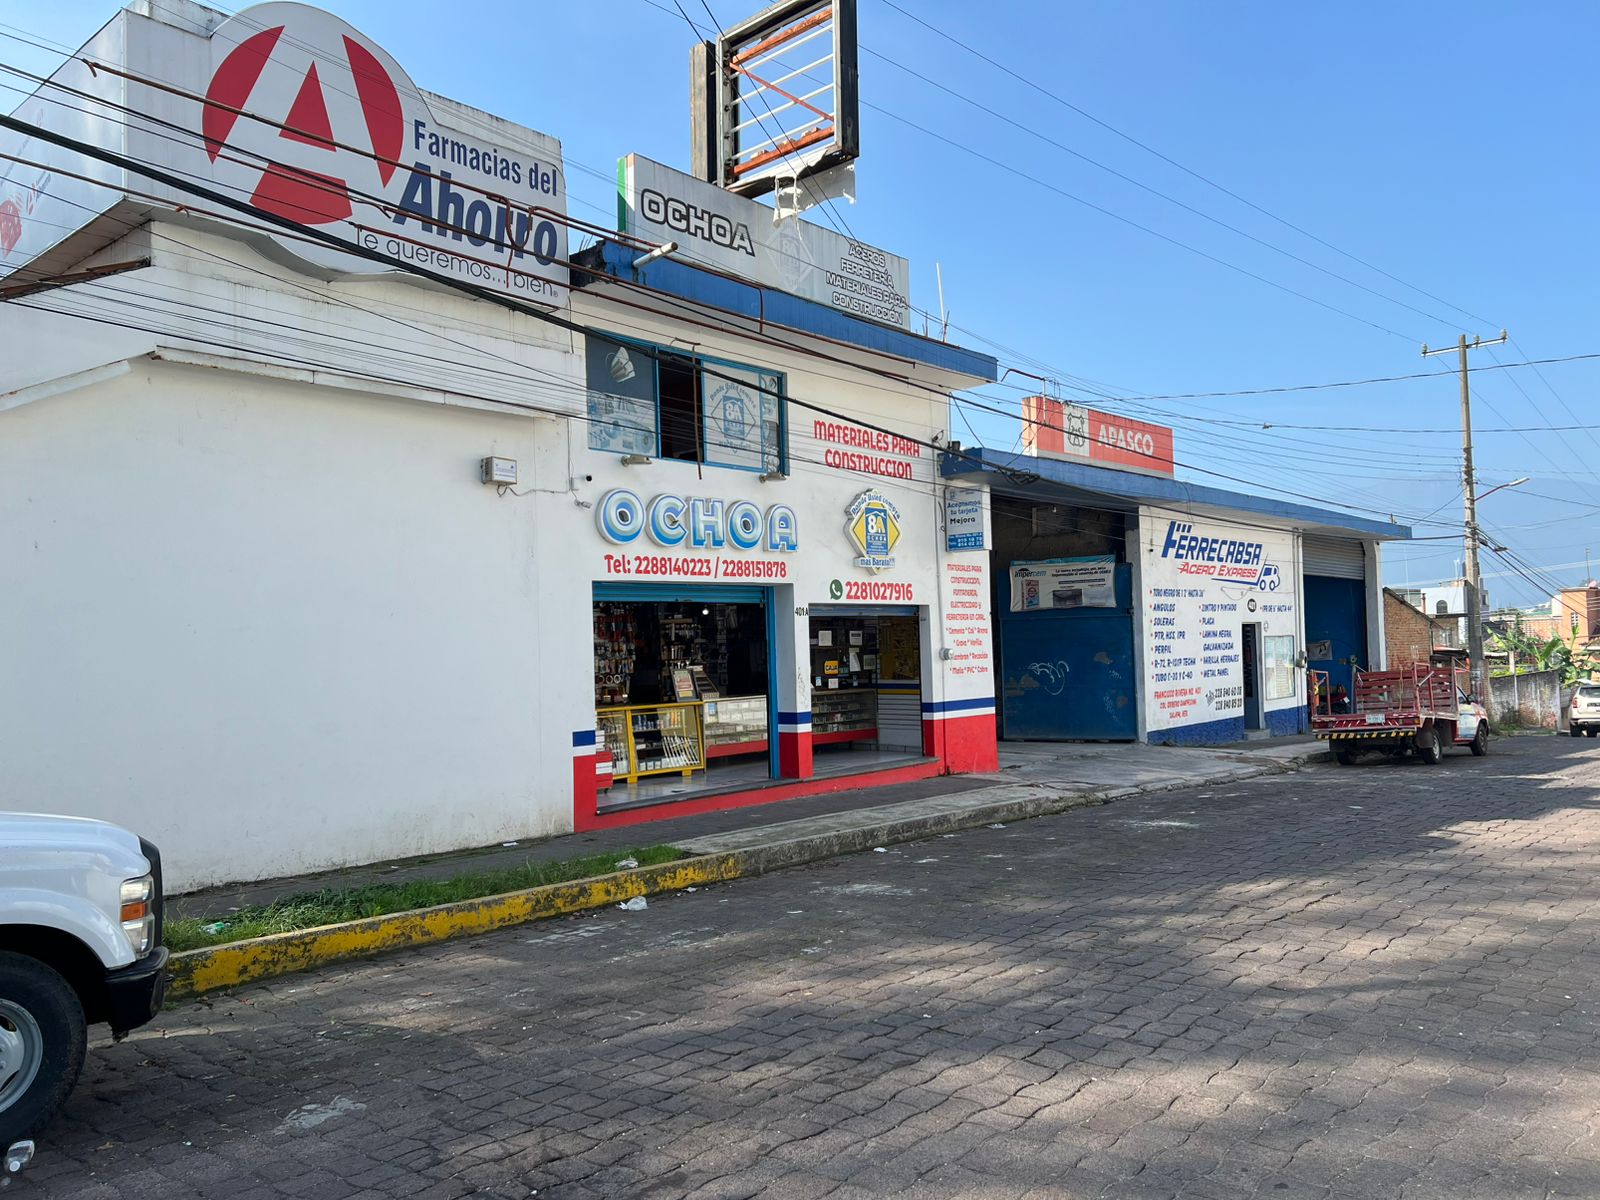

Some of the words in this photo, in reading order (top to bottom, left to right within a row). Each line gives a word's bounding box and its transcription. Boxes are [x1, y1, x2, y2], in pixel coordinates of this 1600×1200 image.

[414, 119, 521, 184] Farmacias
[528, 163, 557, 196] del
[393, 161, 558, 266] Ahorro
[641, 188, 755, 257] OCHOA
[848, 244, 886, 267] ACEROS
[826, 271, 883, 301] MATERIALES
[833, 291, 904, 325] CONSTRUCCIÓN
[813, 420, 889, 452] MATERIALES
[892, 435, 920, 457] PARA
[1098, 425, 1154, 456] APASCO
[825, 448, 912, 480] CONSTRUCCION
[595, 487, 799, 553] OCHOA
[868, 515, 886, 533] 8A
[1161, 521, 1263, 566] FERRECABSA
[604, 554, 631, 575] Tel:
[634, 555, 711, 577] 2288140223
[722, 559, 787, 579] 2288151878
[1178, 561, 1216, 576] ACERO
[845, 581, 913, 601] 2281027916
[1154, 617, 1175, 626] SOLERAS
